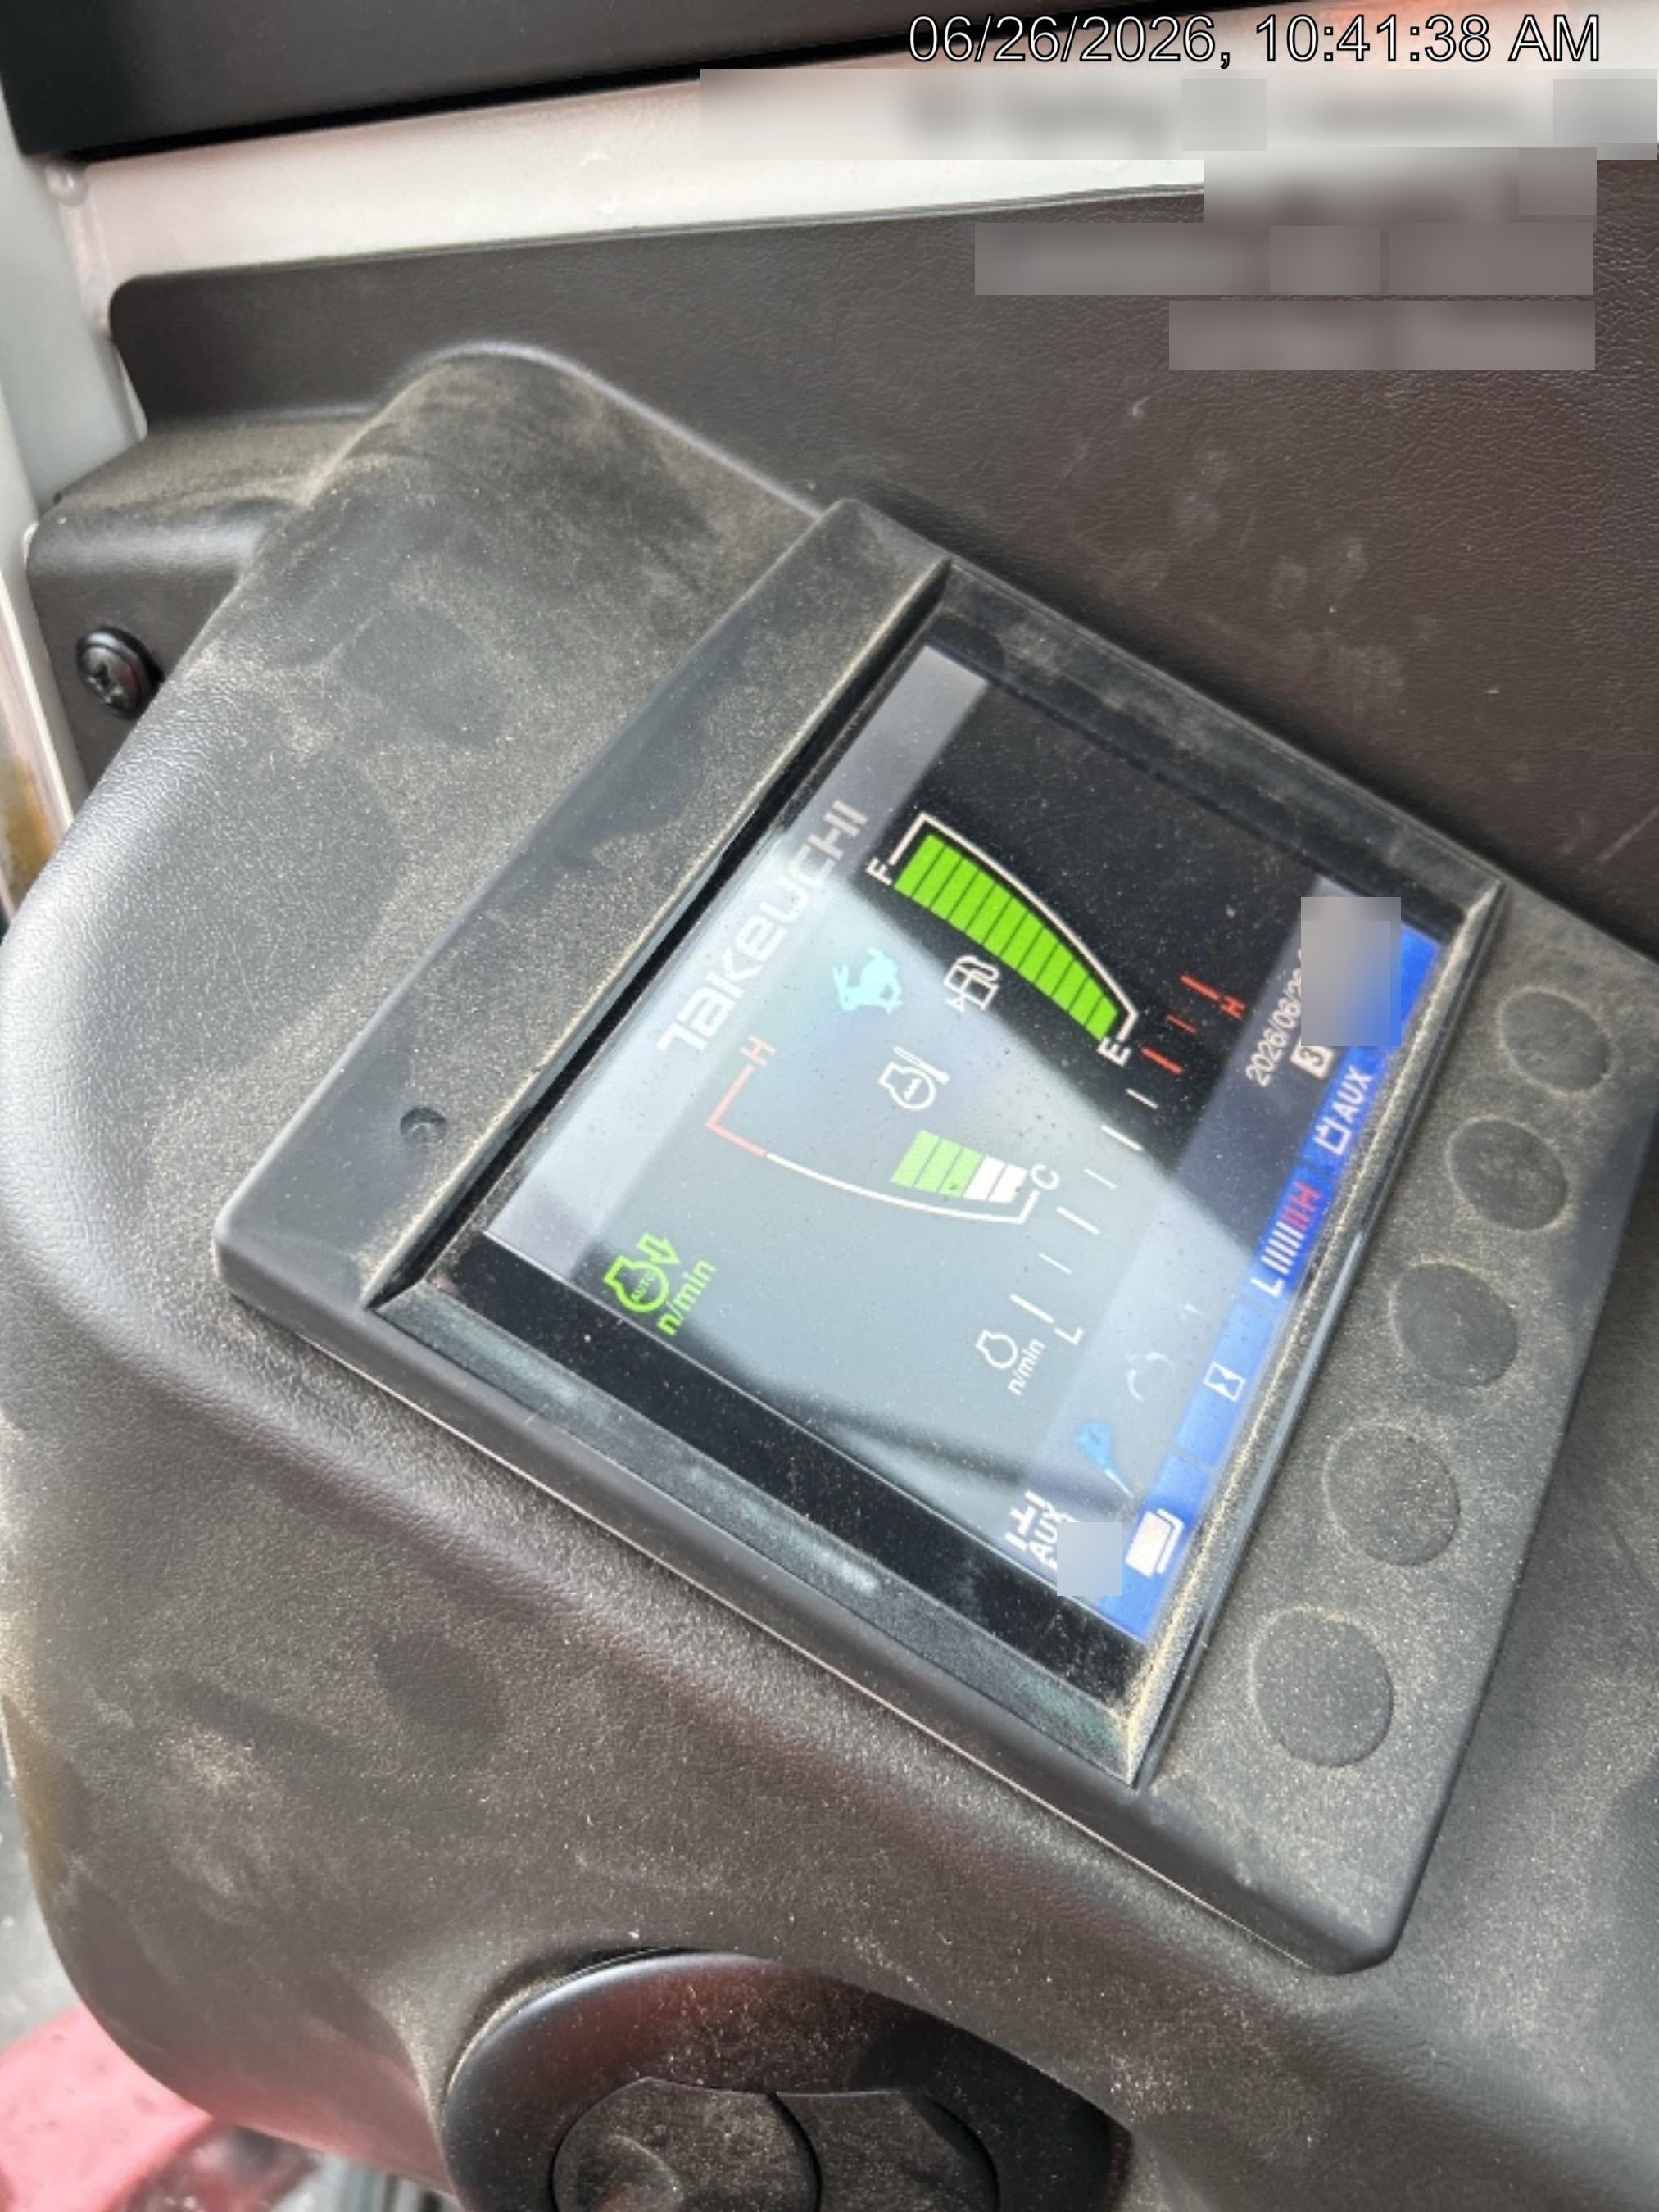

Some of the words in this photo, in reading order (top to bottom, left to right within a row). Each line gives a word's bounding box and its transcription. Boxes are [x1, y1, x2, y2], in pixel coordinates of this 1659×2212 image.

[865, 857, 893, 886] F
[739, 1033, 777, 1066] H
[1097, 1036, 1131, 1067] E
[1330, 1065, 1373, 1124] AUX
[1031, 1164, 1060, 1190] C
[657, 1258, 717, 1336] n/min
[1054, 1325, 1084, 1345] L
[1007, 1338, 1045, 1397] n/min
